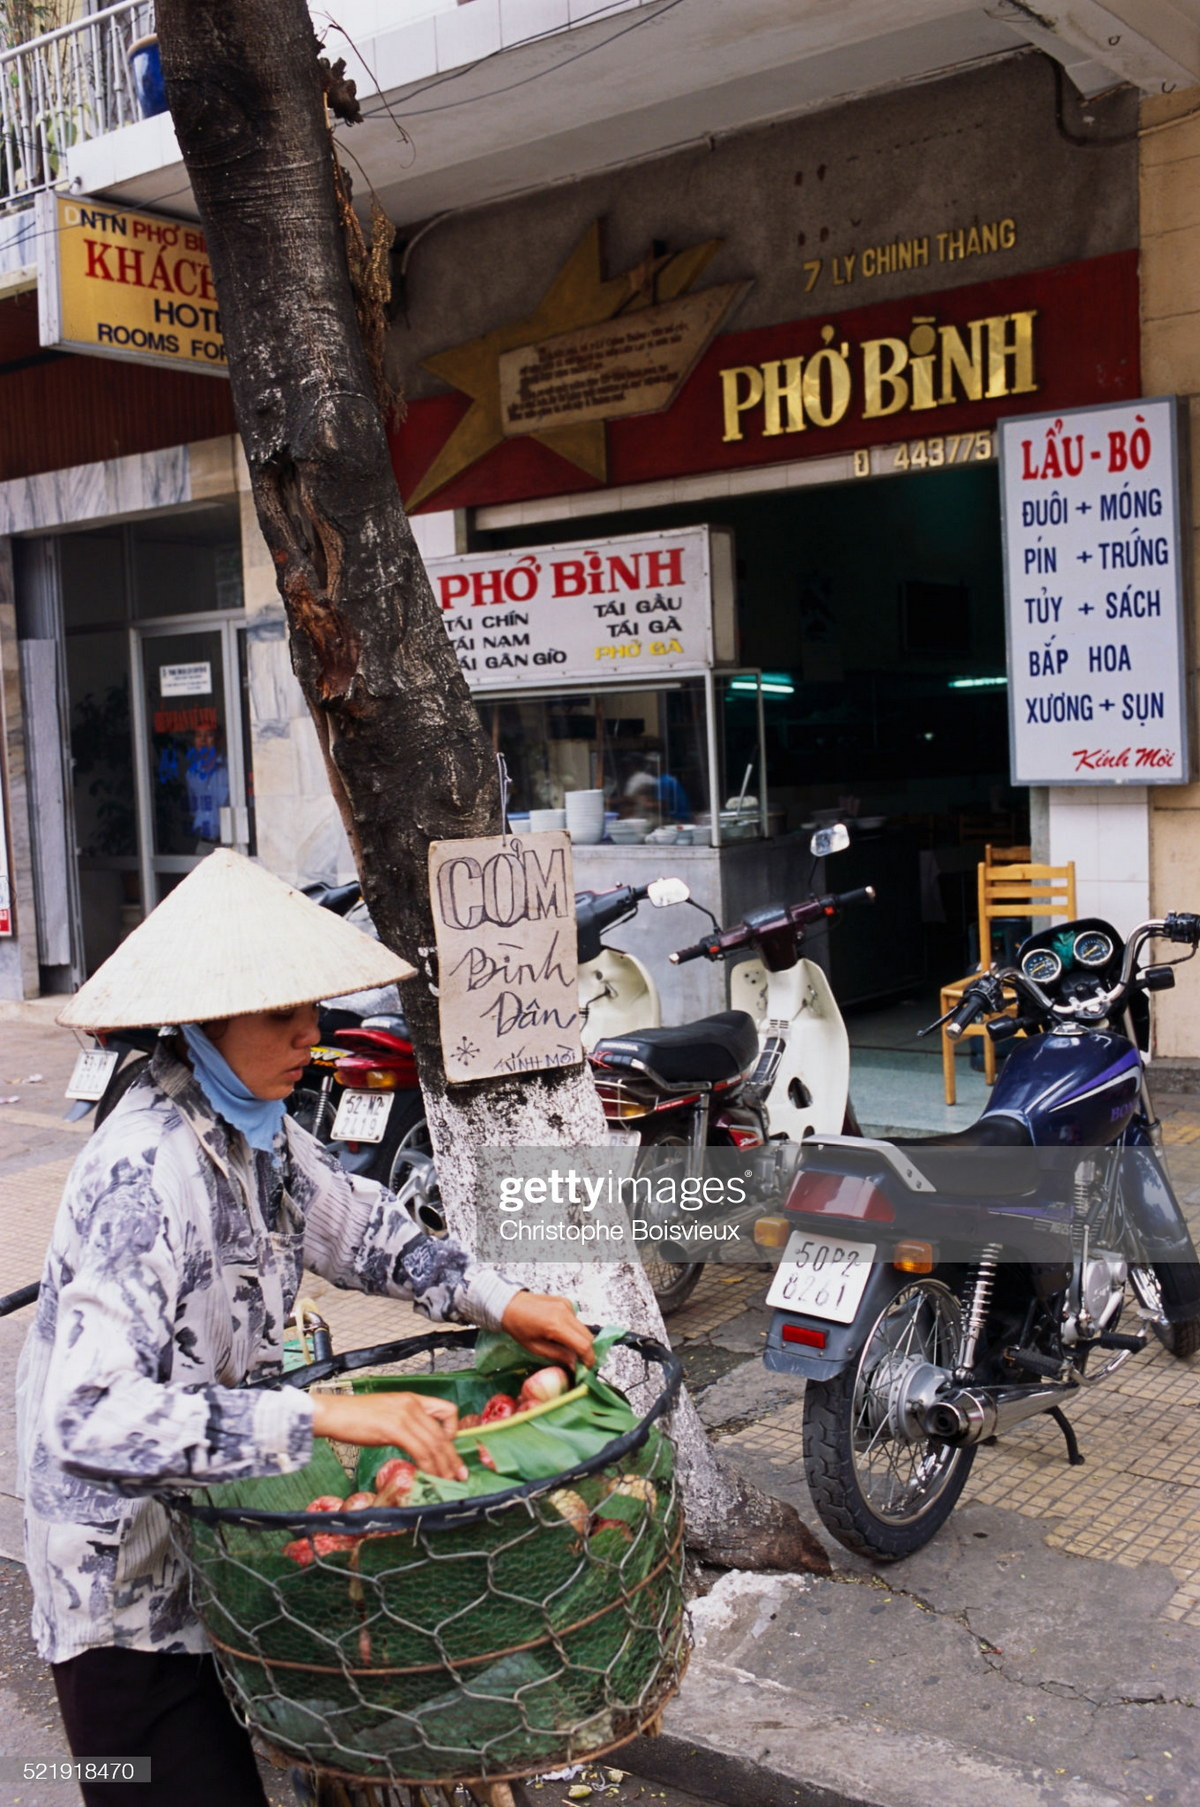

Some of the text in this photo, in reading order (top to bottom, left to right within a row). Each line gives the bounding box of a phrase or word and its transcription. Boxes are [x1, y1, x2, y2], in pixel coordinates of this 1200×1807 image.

[64, 206, 127, 236] DNTN
[803, 260, 822, 292] 7
[98, 323, 179, 353] ROOMS
[719, 324, 851, 442] PHỞ
[860, 310, 1039, 419] BÌNH
[893, 430, 992, 470] 443775
[1021, 418, 1084, 480] LẨU
[1108, 414, 1151, 473] BÒ
[1022, 490, 1068, 527] ĐUÔI
[1100, 481, 1162, 522] MÓNG
[1024, 536, 1057, 575] PÍN
[1098, 527, 1169, 570] TRỨNG
[437, 547, 686, 610] PHỞ BÌNH
[482, 610, 529, 629] CHÍN
[593, 600, 626, 618] TÁI
[1024, 586, 1063, 624] TỦY
[1106, 584, 1161, 619] SÁCH
[606, 615, 683, 638] TÁI GÀ
[457, 655, 477, 671] ÁI
[649, 637, 685, 656] GÀ
[1029, 634, 1132, 677] BẮP HOA
[1025, 692, 1093, 724] XƯƠNG
[1122, 692, 1164, 727] SỤN
[1072, 747, 1131, 772] Kính
[449, 930, 575, 992] Bình
[480, 991, 577, 1037] Dân
